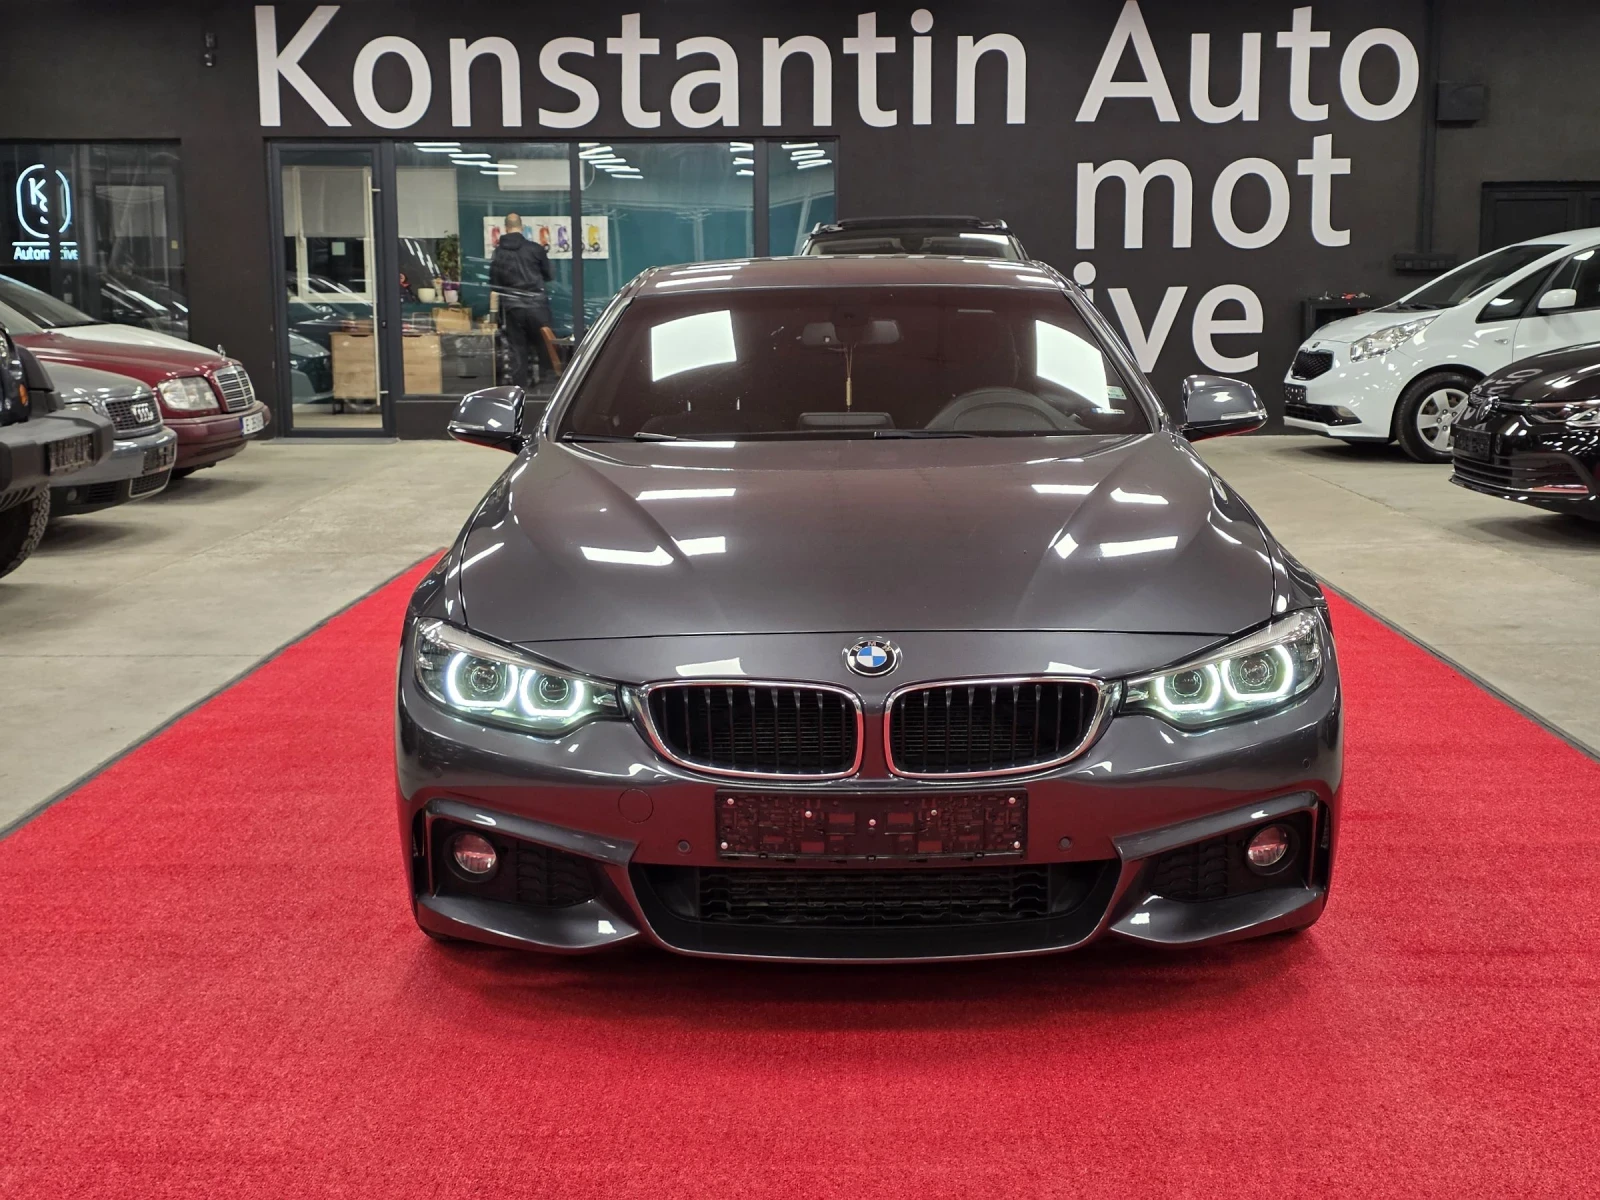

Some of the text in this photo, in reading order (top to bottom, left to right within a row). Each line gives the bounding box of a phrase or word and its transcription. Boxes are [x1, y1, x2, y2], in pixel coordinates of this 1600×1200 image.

[254, 0, 1420, 130] Konstantin Auto
[1075, 133, 1351, 250] mot
